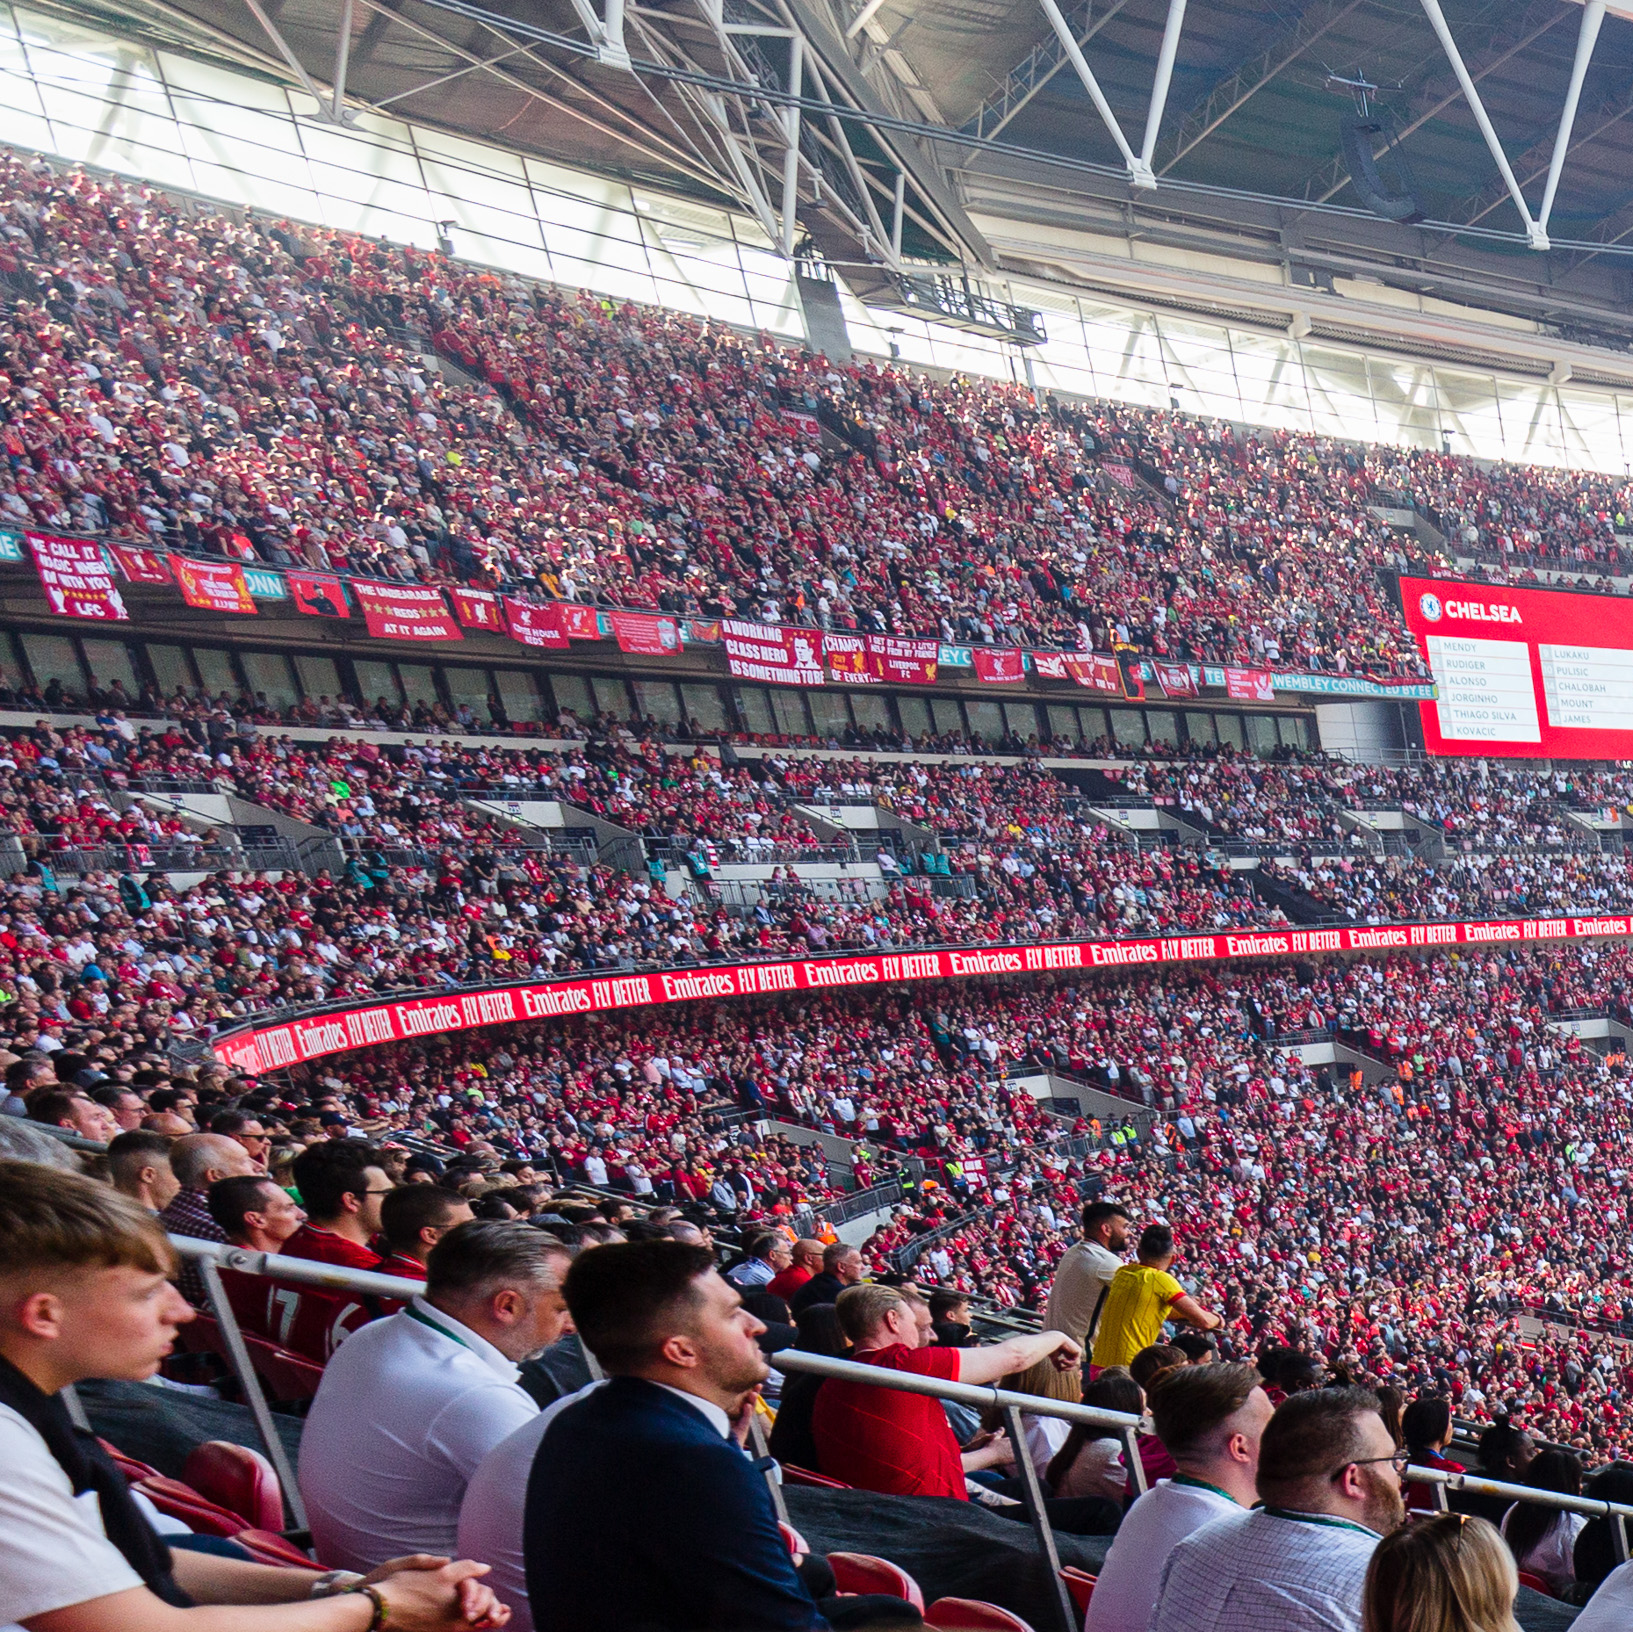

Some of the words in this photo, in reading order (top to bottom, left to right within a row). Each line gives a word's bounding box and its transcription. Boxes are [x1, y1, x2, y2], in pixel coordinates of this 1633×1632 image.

[49, 541, 80, 559] CALL
[82, 546, 96, 560] IT
[73, 560, 110, 574] WHEN
[85, 576, 113, 590] YOU
[353, 582, 376, 597] THE
[375, 585, 441, 600] UNBEARABLE
[74, 601, 106, 616] LFC
[391, 606, 421, 619] REDS
[1445, 600, 1523, 624] CHELSEA
[383, 622, 398, 634] AT
[398, 623, 410, 636] IT
[412, 626, 448, 637] AGAIN
[722, 619, 730, 634] A
[730, 620, 783, 643] WORKING
[725, 639, 760, 660] CLASS
[760, 645, 789, 664] HERO
[870, 644, 886, 654] HELP
[914, 649, 937, 659] FRIENDS
[917, 642, 938, 651] LITTLE
[1443, 641, 1477, 653] MENDY
[1554, 650, 1590, 661] LUKAKU
[888, 659, 921, 671] LIVERPOOL
[1446, 659, 1486, 670] RUDIGER
[1556, 666, 1589, 677] PULISIC
[729, 659, 741, 675] IS
[741, 661, 801, 684] SOMETHING
[800, 669, 812, 684] TO
[811, 670, 825, 685] BE
[831, 669, 842, 681] OF
[900, 670, 911, 679] FC
[1272, 673, 1330, 691] WEMBLEY
[1331, 679, 1401, 696] CONNECTED
[1402, 683, 1417, 696] BY
[1418, 684, 1432, 697] EE
[1449, 676, 1487, 687] ALONSO
[1558, 682, 1607, 693] CHALOBAH
[1450, 692, 1498, 704] JORGINHO
[1561, 698, 1594, 709] MOUNT
[1454, 709, 1489, 720] THIAGO
[1491, 709, 1517, 721] SILVA
[1562, 714, 1592, 724] JAMES
[1456, 726, 1496, 737] KOVACIC
[1464, 921, 1520, 943] Emirates
[1523, 922, 1538, 940] FLY
[1538, 920, 1567, 938] BETTER
[1227, 934, 1289, 957] Emirates
[1292, 932, 1308, 953] FLY
[1308, 930, 1341, 951] BETTER
[804, 960, 879, 987] Emirates
[882, 957, 901, 981] FLY
[901, 953, 940, 979] BETTER
[663, 970, 734, 1001] Emirates
[737, 967, 757, 995] FLY
[758, 964, 796, 992] BETTER
[522, 987, 591, 1018] Emirates
[591, 981, 612, 1009] FLY
[612, 977, 652, 1006] BETTER
[297, 1022, 346, 1057] Emirates
[345, 1012, 364, 1046] FLY
[363, 1008, 394, 1044] BETTER
